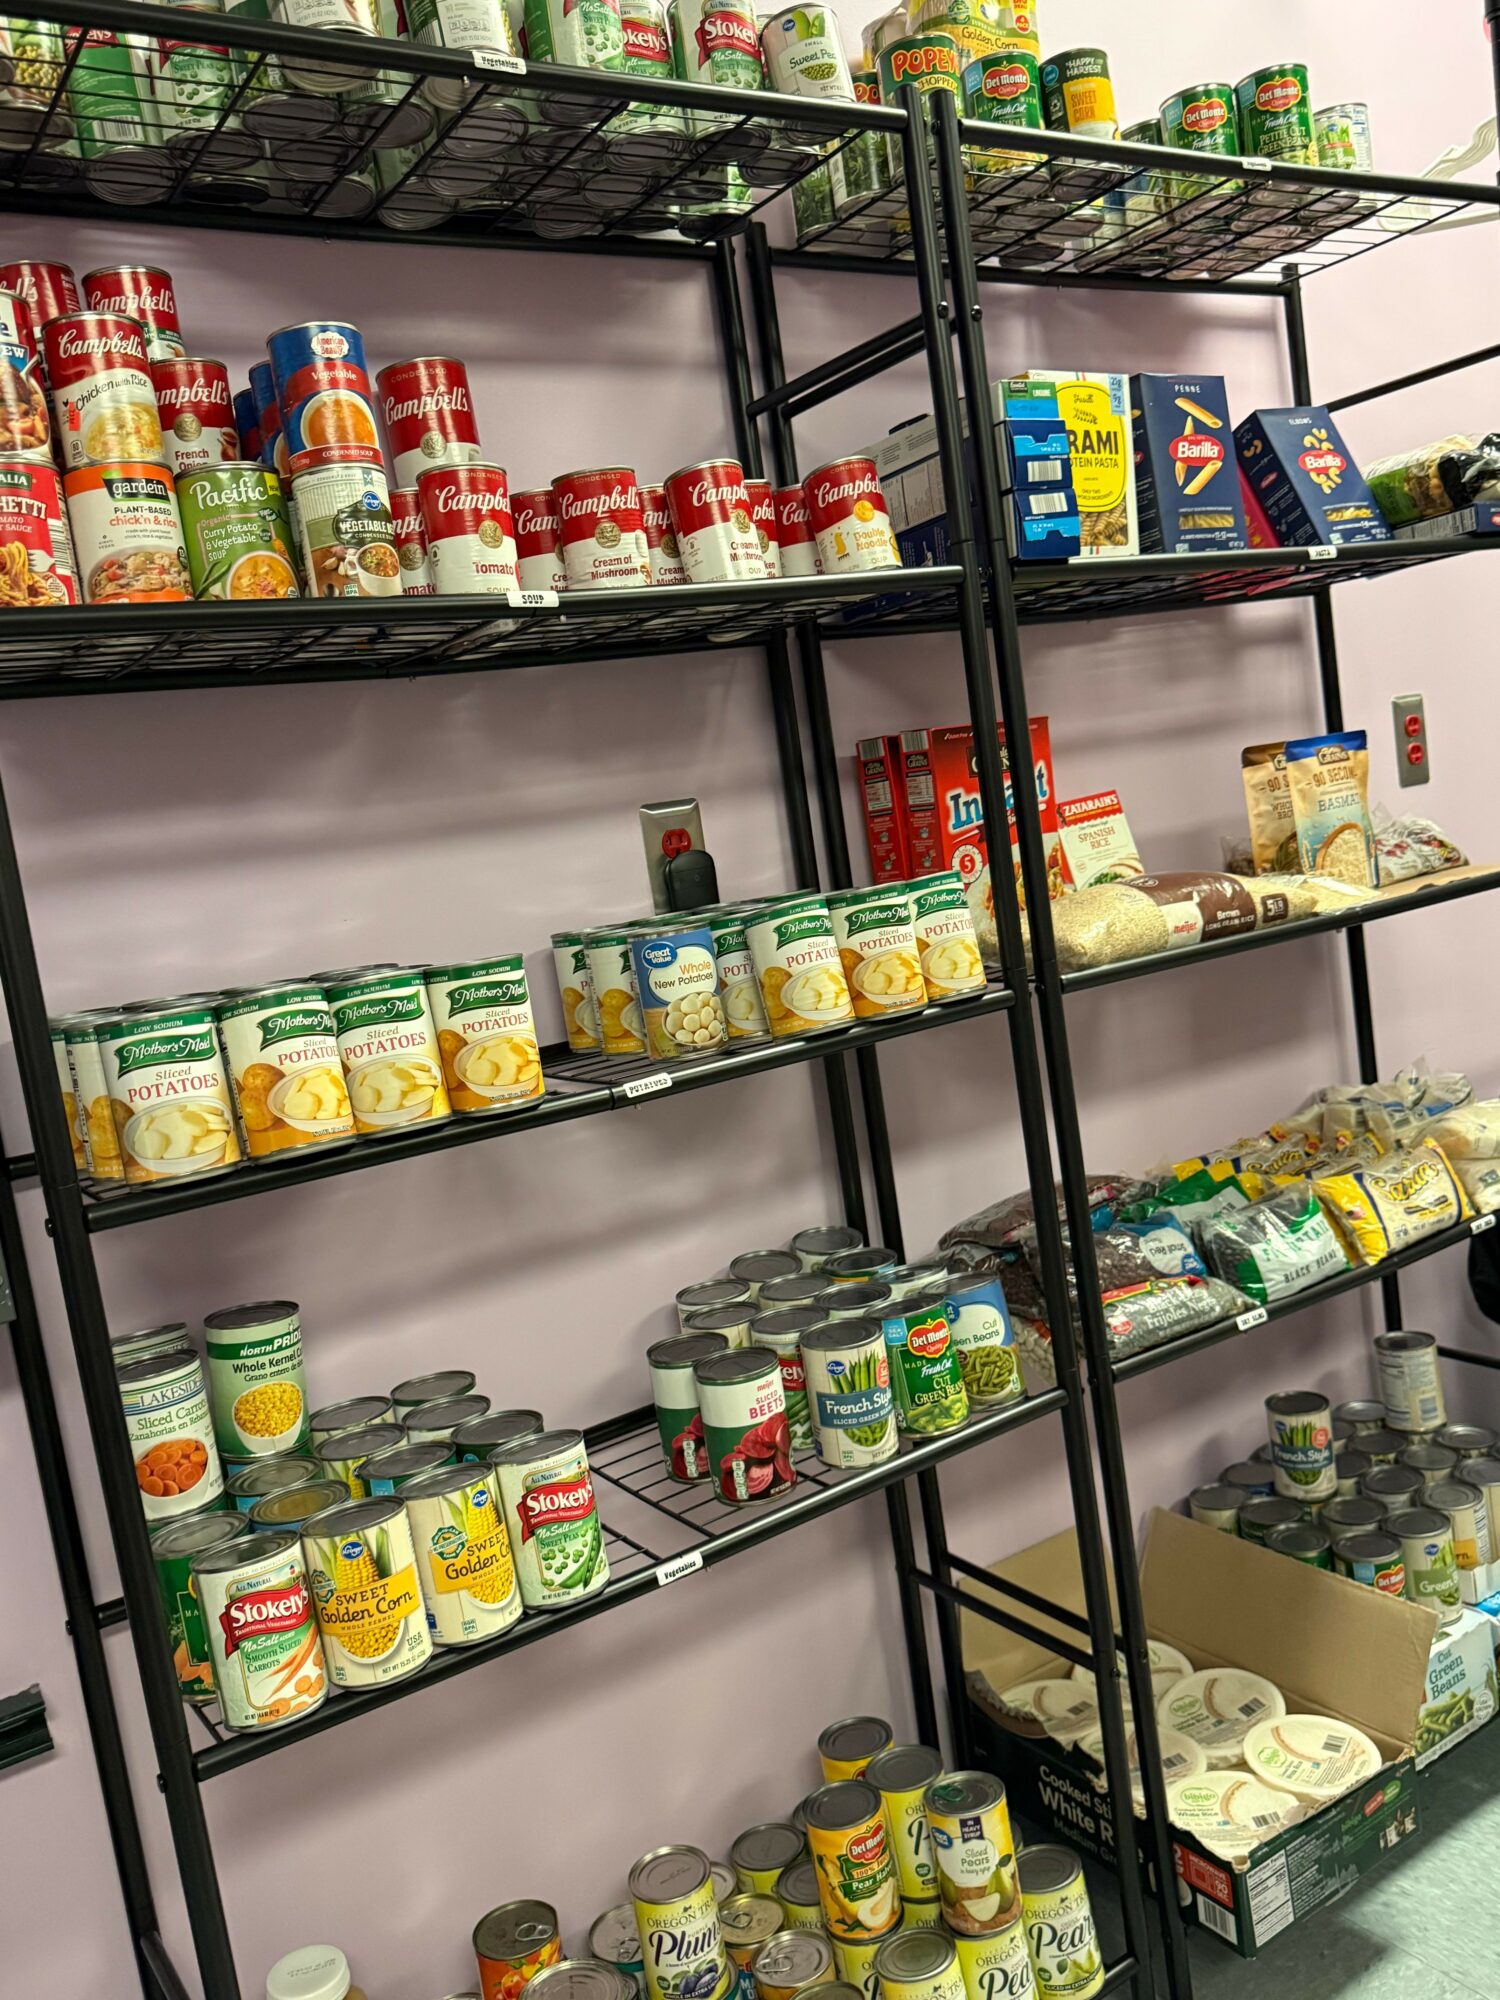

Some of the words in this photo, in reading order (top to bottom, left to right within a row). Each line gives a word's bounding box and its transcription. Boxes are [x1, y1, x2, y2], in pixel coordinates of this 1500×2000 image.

[962, 26, 994, 48] Golden
[995, 38, 1019, 51] Corn
[789, 53, 820, 70] Sweet
[1067, 56, 1096, 68] HAPPY
[1066, 63, 1102, 78] HARVEST
[986, 76, 999, 89] Del
[1000, 73, 1028, 87] Monte
[1070, 90, 1097, 107] SWEET
[1073, 106, 1097, 124] CORN
[58, 328, 144, 361] Campbell's
[311, 370, 357, 381] Vegetable
[390, 366, 448, 384] CONDENSED
[74, 379, 115, 412] Chicken
[115, 377, 130, 388] with
[131, 373, 148, 388] Rice
[1174, 384, 1201, 394] PENNE
[384, 386, 469, 426] Campbell's
[175, 449, 210, 461] French
[322, 449, 360, 458] CONDENSED
[360, 449, 374, 457] SOUP
[1177, 441, 1220, 459] Barilla
[1094, 457, 1119, 469] PASTA
[1304, 454, 1342, 469] Barilla
[112, 478, 167, 498] gardein
[189, 476, 268, 510] Pacific
[113, 506, 172, 516] PLANT-BASED
[5, 524, 33, 533] SAUCE
[109, 514, 151, 527] chick'n
[153, 515, 162, 526] &
[162, 517, 178, 529] rice
[340, 519, 386, 533] VEGETABLE
[203, 528, 226, 538] Curry
[227, 522, 258, 534] Potato
[853, 528, 886, 542] Double
[212, 533, 257, 549] Vegetable
[855, 537, 889, 551] Noodle
[209, 550, 227, 561] SOUP
[592, 556, 623, 569] Cream
[623, 553, 633, 565] of
[473, 561, 515, 576] Tomato
[590, 566, 639, 581] Mushroom
[521, 594, 544, 605] SOUP
[1266, 776, 1280, 793] 90
[1312, 771, 1327, 787] 90
[1063, 793, 1118, 817] ZATARAIN'S
[1078, 826, 1116, 843] SPANISH
[1090, 837, 1111, 850] RICE
[963, 856, 972, 869] 5
[1216, 908, 1240, 920] Brown
[1173, 920, 1197, 934] meijer
[859, 931, 913, 951] POTATOES
[645, 946, 671, 960] Great
[651, 954, 673, 964] Value
[472, 969, 488, 977] LOW
[679, 960, 712, 975] Whole
[654, 977, 676, 990] New
[676, 970, 714, 986] Potatoes
[453, 985, 503, 1008] Mother's
[339, 1000, 387, 1027] Mother's
[384, 998, 418, 1019] Maid
[485, 1007, 510, 1019] Sliced
[134, 1025, 152, 1034] LOW
[153, 1019, 183, 1031] SODIUM
[461, 1012, 529, 1035] POTATOES
[366, 1025, 399, 1040] Sliced
[122, 1041, 179, 1067] Mother's
[176, 1037, 211, 1057] Maid
[343, 1031, 427, 1062] POTATOES
[155, 1066, 192, 1081] Sliced
[127, 1072, 219, 1104] POTATOES
[628, 1078, 669, 1094] POTATOES
[1283, 1265, 1311, 1285] BLACK
[982, 1319, 998, 1330] Cut
[1144, 1306, 1188, 1329] Frijoles
[911, 1335, 926, 1347] Del
[973, 1329, 1000, 1344] Beans
[239, 1344, 272, 1357] NORTH
[232, 1360, 267, 1375] Whole
[268, 1350, 297, 1368] Kernel
[904, 1359, 927, 1370] MADE
[921, 1362, 942, 1378] Fresh
[244, 1370, 269, 1382] Grano
[269, 1367, 290, 1378] entero
[756, 1379, 775, 1392] meijer
[932, 1377, 952, 1389] CUT
[139, 1377, 201, 1409] LAKESIDE
[755, 1390, 779, 1405] SLICED
[914, 1389, 946, 1404] GREEN
[748, 1395, 784, 1420] BEETS
[826, 1397, 872, 1416] French
[137, 1409, 174, 1431] Sliced
[178, 1421, 188, 1430] en
[833, 1417, 858, 1425] SLICED
[858, 1412, 880, 1424] GREEN
[466, 1530, 506, 1558] SWEET
[540, 1536, 562, 1549] SWEET
[563, 1532, 580, 1545] PEAS
[445, 1552, 500, 1581] Golden
[664, 1559, 697, 1580] Vegetables
[247, 1577, 273, 1589] NATURAL
[471, 1568, 495, 1582] WHOLE
[1419, 1577, 1452, 1593] Green
[335, 1582, 389, 1607] SWEET
[229, 1588, 309, 1629] Stokely's
[319, 1607, 374, 1625] Golden
[375, 1593, 412, 1616] Corn
[341, 1623, 365, 1632] WHOLE
[367, 1614, 396, 1628] KERNEL
[406, 1632, 423, 1646] USA
[244, 1649, 279, 1664] SMOOTH
[279, 1638, 302, 1655] SLICED
[1437, 1651, 1453, 1664] Cut
[246, 1658, 281, 1674] CARROTS
[1428, 1655, 1464, 1686] Green
[1431, 1668, 1467, 1700] Beans
[1039, 1764, 1091, 1805] Cooked
[1038, 1782, 1096, 1836] White
[962, 1825, 981, 1833] HEAVY
[963, 1831, 981, 1840] SYRUP
[1052, 1817, 1099, 1852] Medium
[851, 1843, 863, 1855] Del
[960, 1855, 990, 1867] Pears
[855, 1865, 875, 1879] 100%
[852, 1877, 873, 1891] Pear
[1214, 1880, 1229, 1895] 90
[1025, 1901, 1073, 1920] OREGON
[646, 1910, 697, 1929] OREGON
